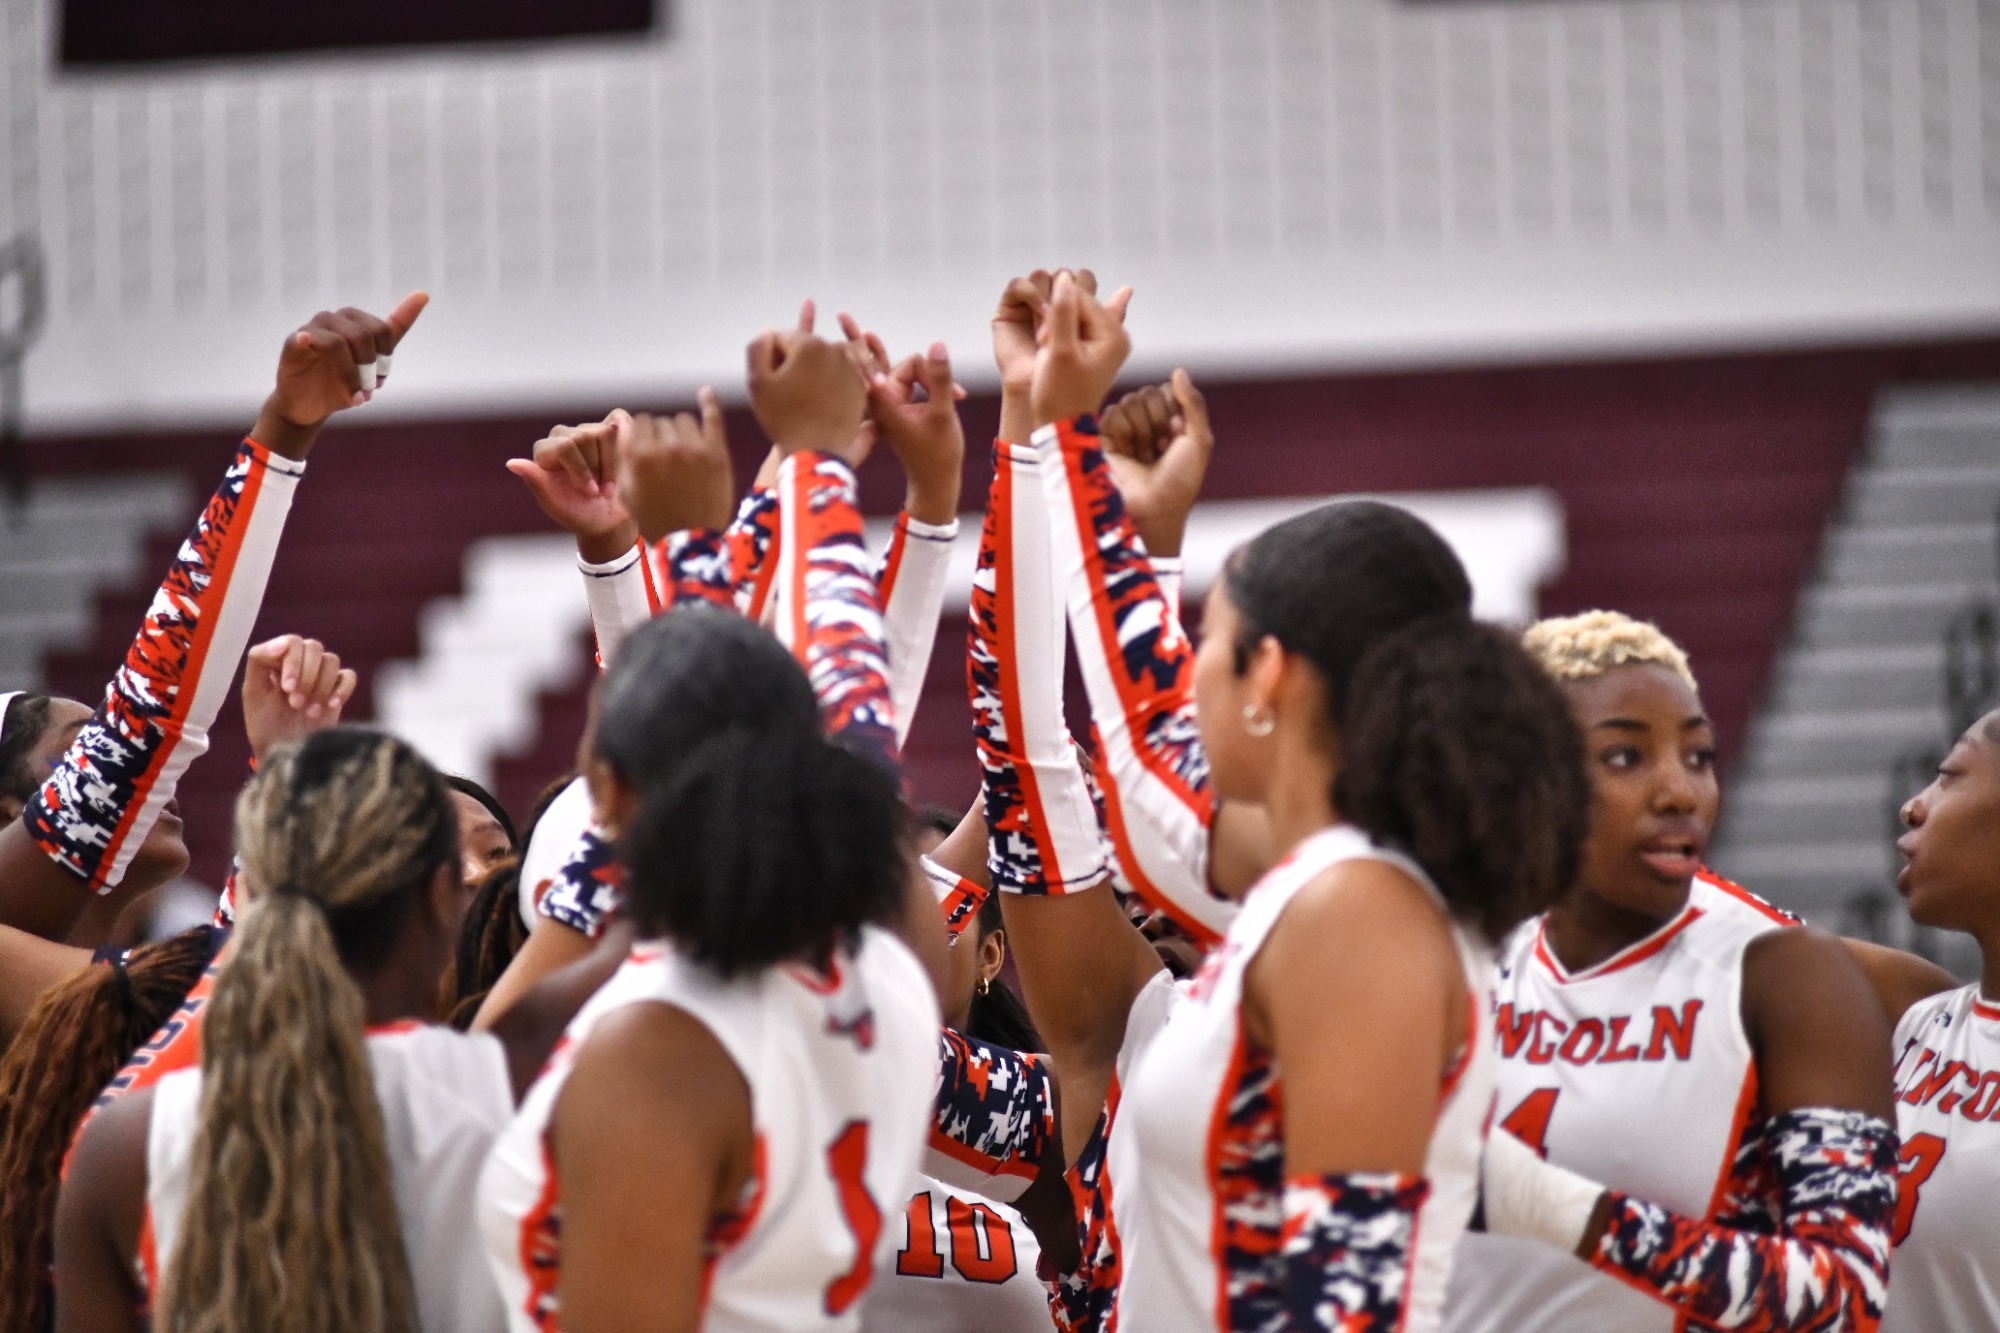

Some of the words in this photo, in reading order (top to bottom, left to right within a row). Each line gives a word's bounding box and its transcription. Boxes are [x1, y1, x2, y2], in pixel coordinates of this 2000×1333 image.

[1490, 998, 1704, 1066] NCOLN
[1893, 1037, 2000, 1122] LINCO
[896, 1191, 1018, 1284] 10
